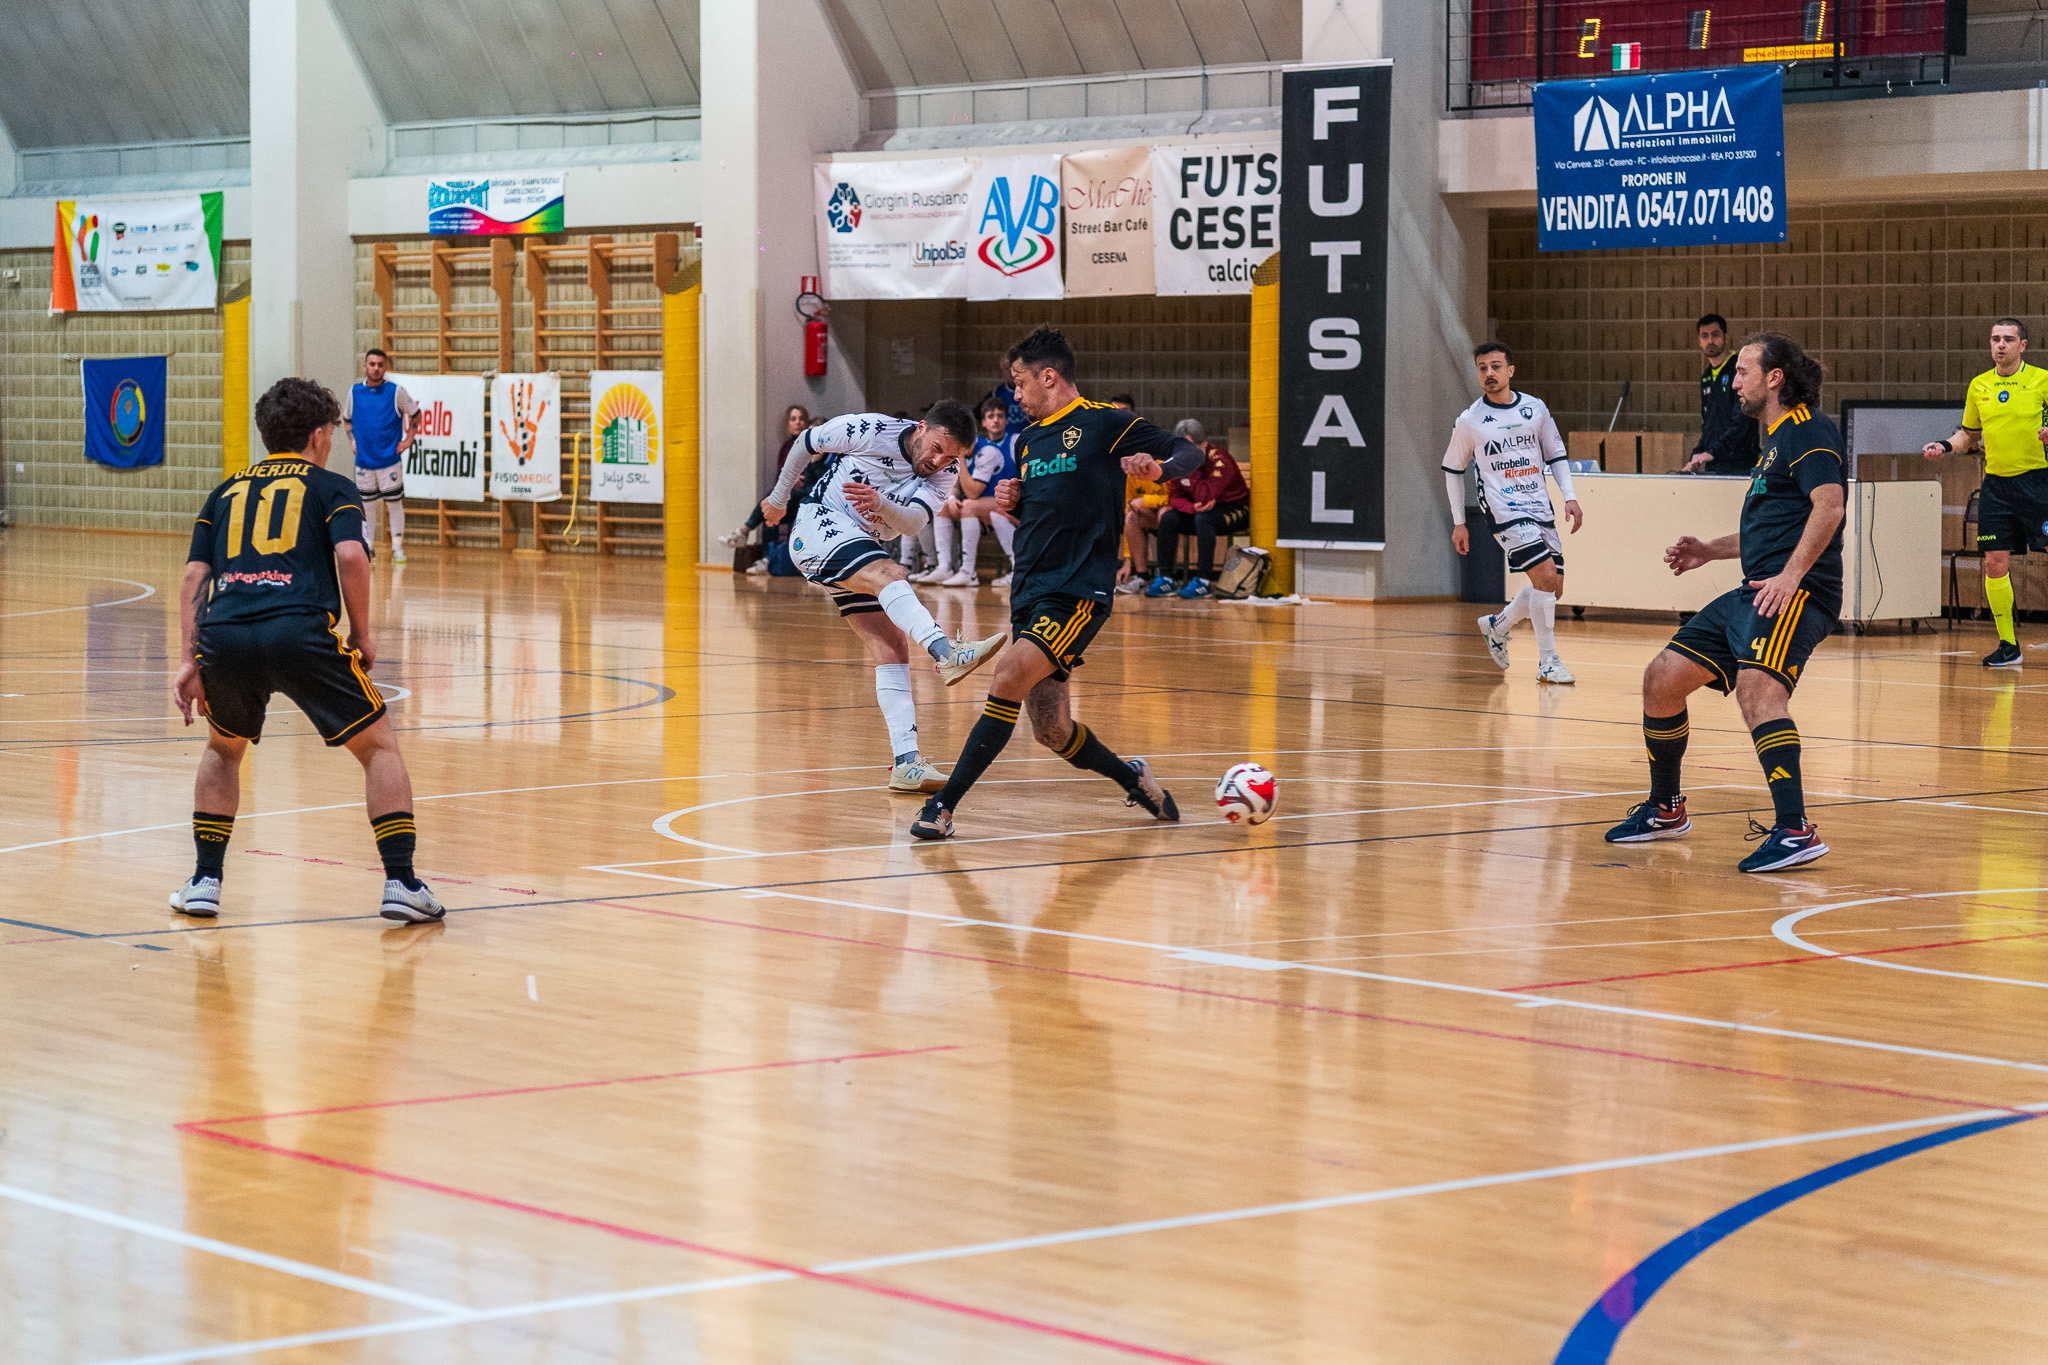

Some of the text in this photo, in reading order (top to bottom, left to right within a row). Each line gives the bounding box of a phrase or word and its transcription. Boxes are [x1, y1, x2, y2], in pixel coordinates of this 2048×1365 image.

[1578, 18, 1601, 58] 2
[1622, 86, 1736, 133] ALPHA
[1622, 132, 1737, 149] mediazioni immobiliari
[1554, 161, 1566, 170] Via
[1609, 157, 1634, 167] Cesena
[1637, 156, 1647, 165] FC
[1711, 151, 1724, 160] REA
[1180, 152, 1281, 199] FUTS
[1621, 171, 1687, 188] PROPONE IN
[864, 192, 969, 212] Giorgini Rusciano
[1541, 185, 1775, 232] VENDITA 0547.071408
[979, 174, 1060, 256] AVB
[1071, 221, 1102, 235] Street
[1104, 219, 1123, 233] Bar
[1170, 204, 1275, 250] CESE
[1091, 252, 1128, 264] CESENA
[1302, 86, 1367, 525] FUTSAL
[406, 438, 478, 478] Ricambi
[1028, 452, 1078, 479] Todis
[1491, 456, 1531, 472] Vitobello
[494, 472, 554, 485] FISIOMEDIC
[626, 472, 650, 485] SRL
[221, 477, 307, 559] 10
[1032, 616, 1062, 641] 20
[1751, 637, 1767, 660] 4
